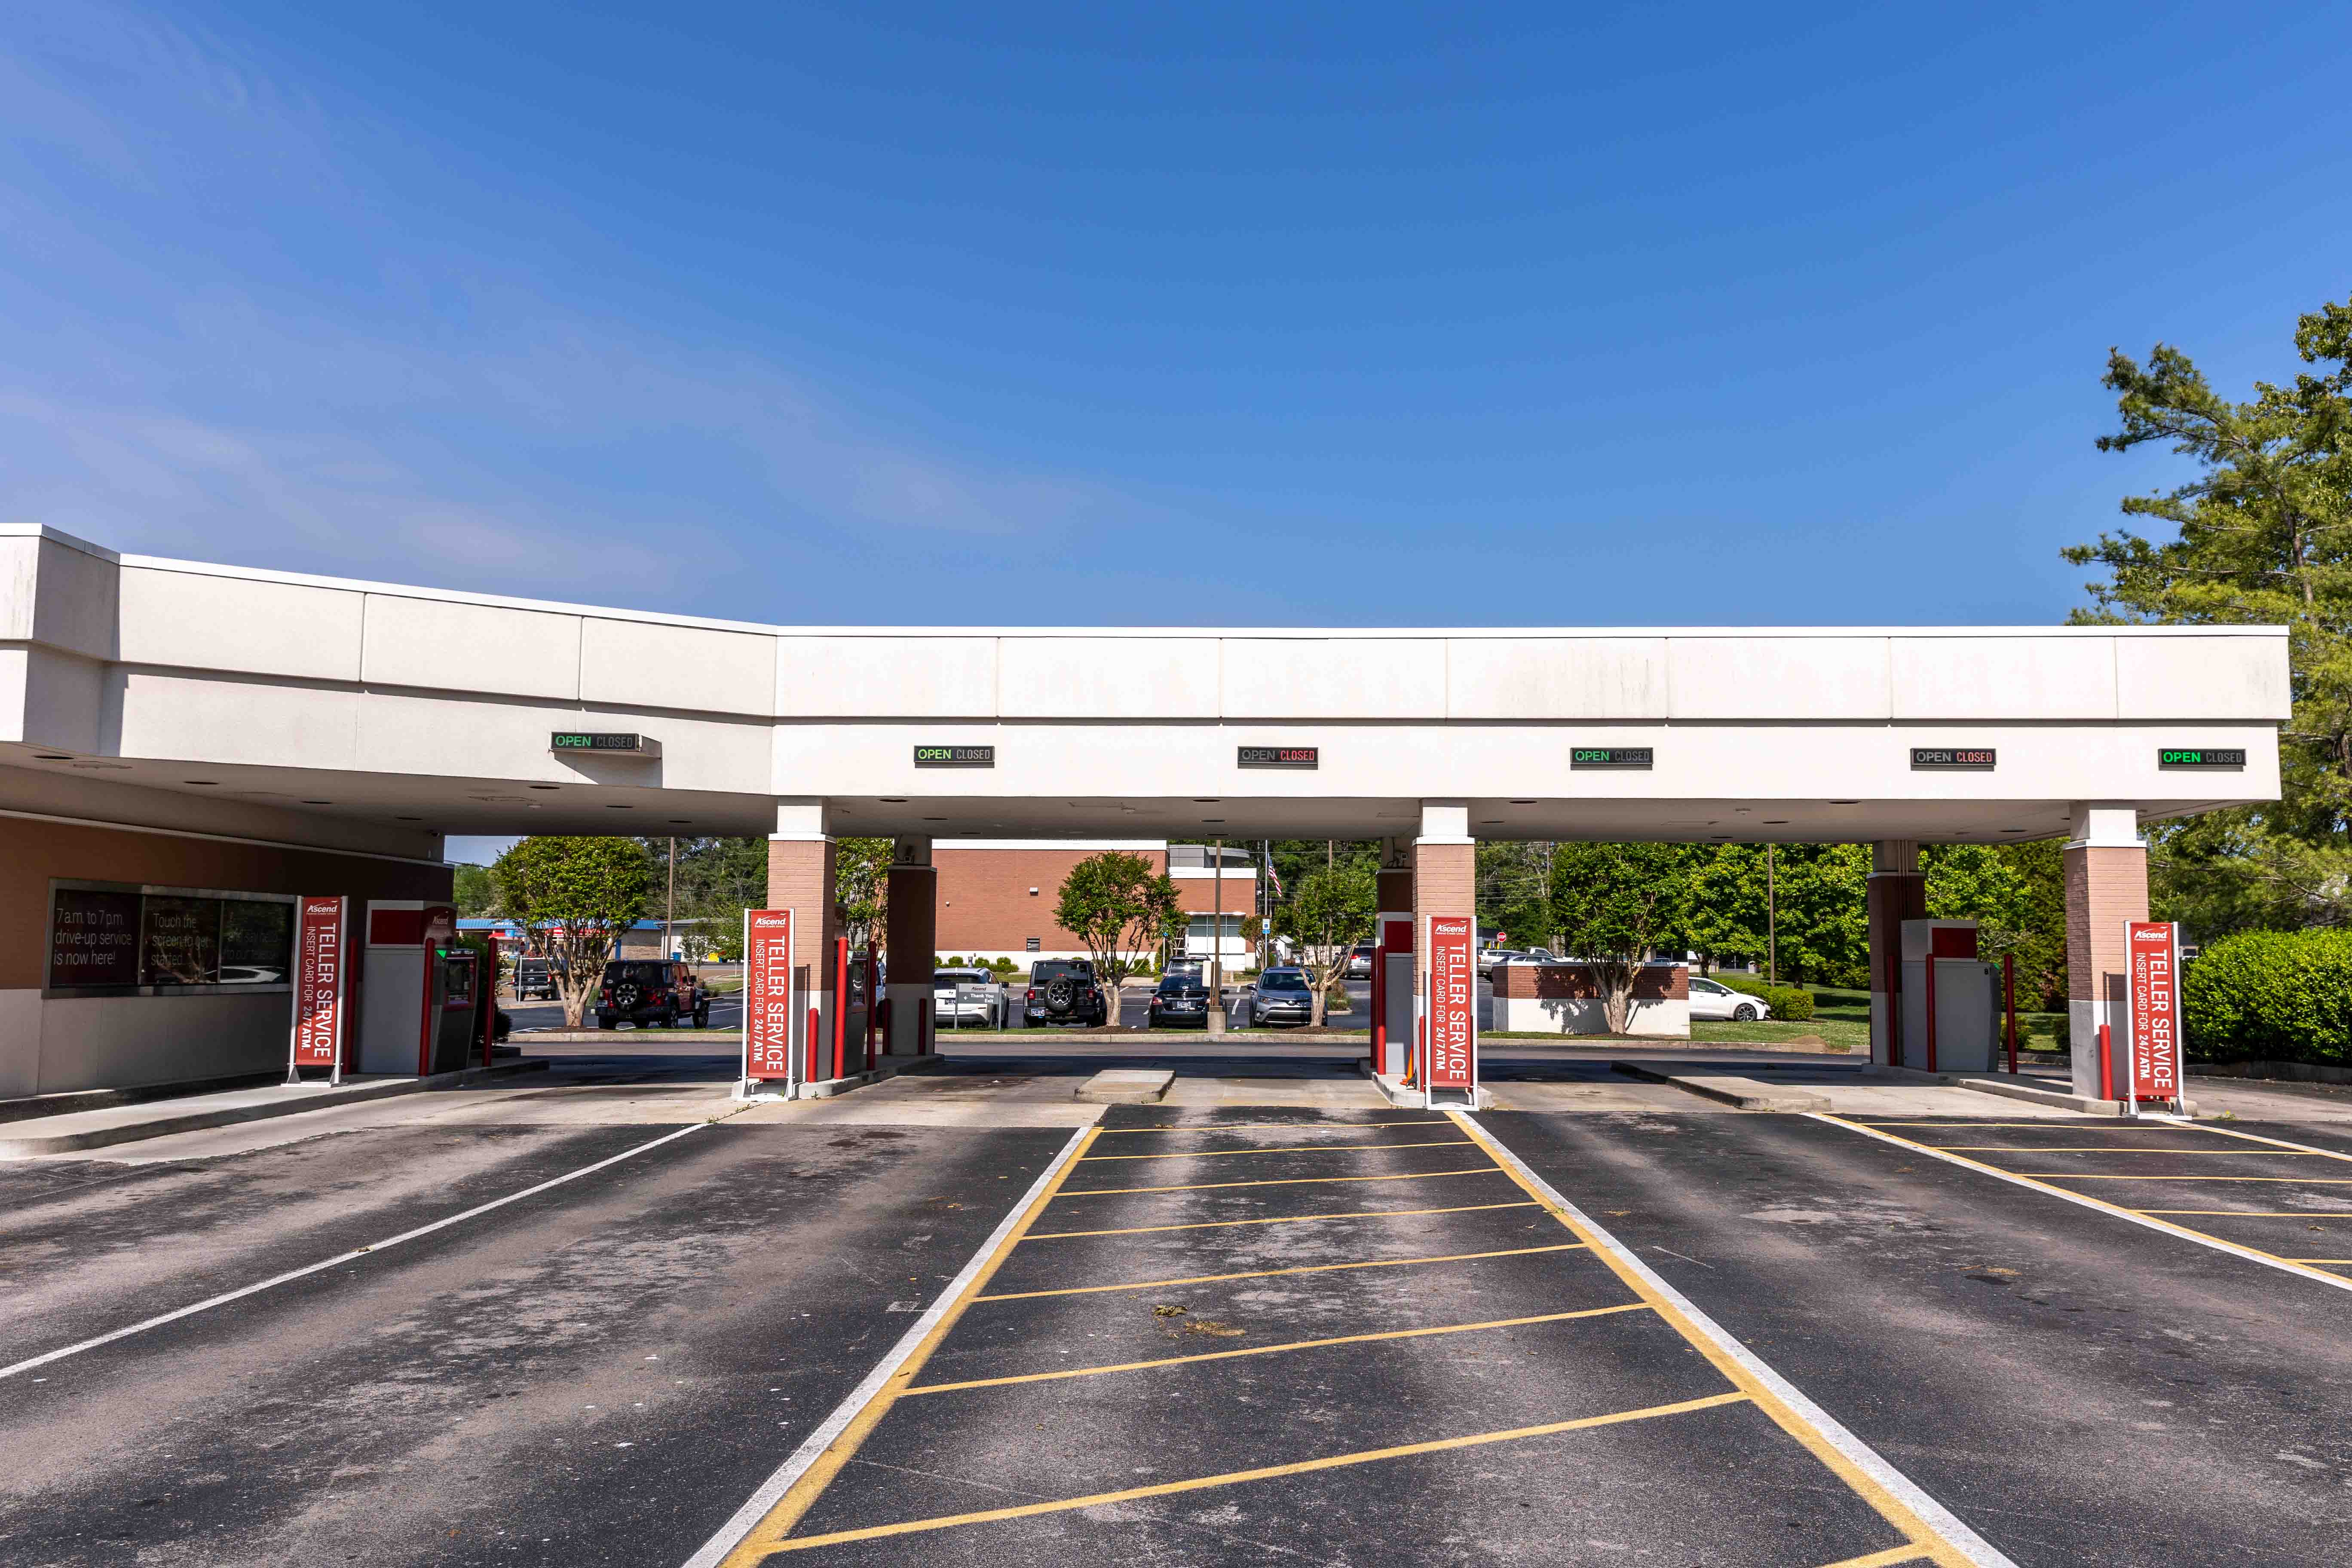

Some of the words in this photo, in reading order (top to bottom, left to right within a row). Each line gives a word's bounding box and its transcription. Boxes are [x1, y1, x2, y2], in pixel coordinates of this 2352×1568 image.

[556, 735, 591, 746] OPEN
[597, 736, 633, 747] CLOSED
[918, 749, 951, 759] OPEN
[956, 749, 990, 759] CLOSED
[1242, 750, 1275, 760] OPEN
[1280, 750, 1314, 760] CLOSED
[1575, 751, 1610, 761] OPEN
[1615, 751, 1650, 761] CLOSED
[1916, 752, 1951, 762] OPEN
[1957, 752, 1992, 762] CLOSED
[2163, 752, 2201, 763] OPEN
[2206, 752, 2242, 763] CLOSED
[86, 910, 97, 924] to
[153, 913, 181, 928] Touch
[183, 914, 197, 928] the
[55, 928, 97, 948] drive-up
[99, 931, 132, 945] service
[152, 935, 182, 947] screen
[306, 926, 316, 956] INSERT
[54, 949, 63, 965] is
[65, 952, 89, 965] now
[91, 949, 116, 965] here!
[318, 923, 336, 983] TELLER
[756, 939, 765, 970] INSERT
[1436, 946, 1446, 977] INSERT
[305, 959, 315, 982] CARD
[768, 935, 785, 996] TELLER
[1449, 943, 1466, 1004] TELLER
[2136, 952, 2147, 984] INSERT
[755, 971, 764, 995] CARD
[1436, 979, 1446, 1003] CARD
[2150, 949, 2169, 1011] TELLER
[303, 985, 313, 1001] FOR
[2137, 986, 2148, 1010] CARD
[754, 997, 764, 1014] FOR
[1436, 1005, 1446, 1023] FOR
[314, 989, 333, 1057] SERVICE
[2138, 1012, 2148, 1030] FOR
[766, 1002, 784, 1070] SERVICE
[1449, 1011, 1466, 1080] SERVICE
[2152, 1018, 2172, 1088] SERVICE
